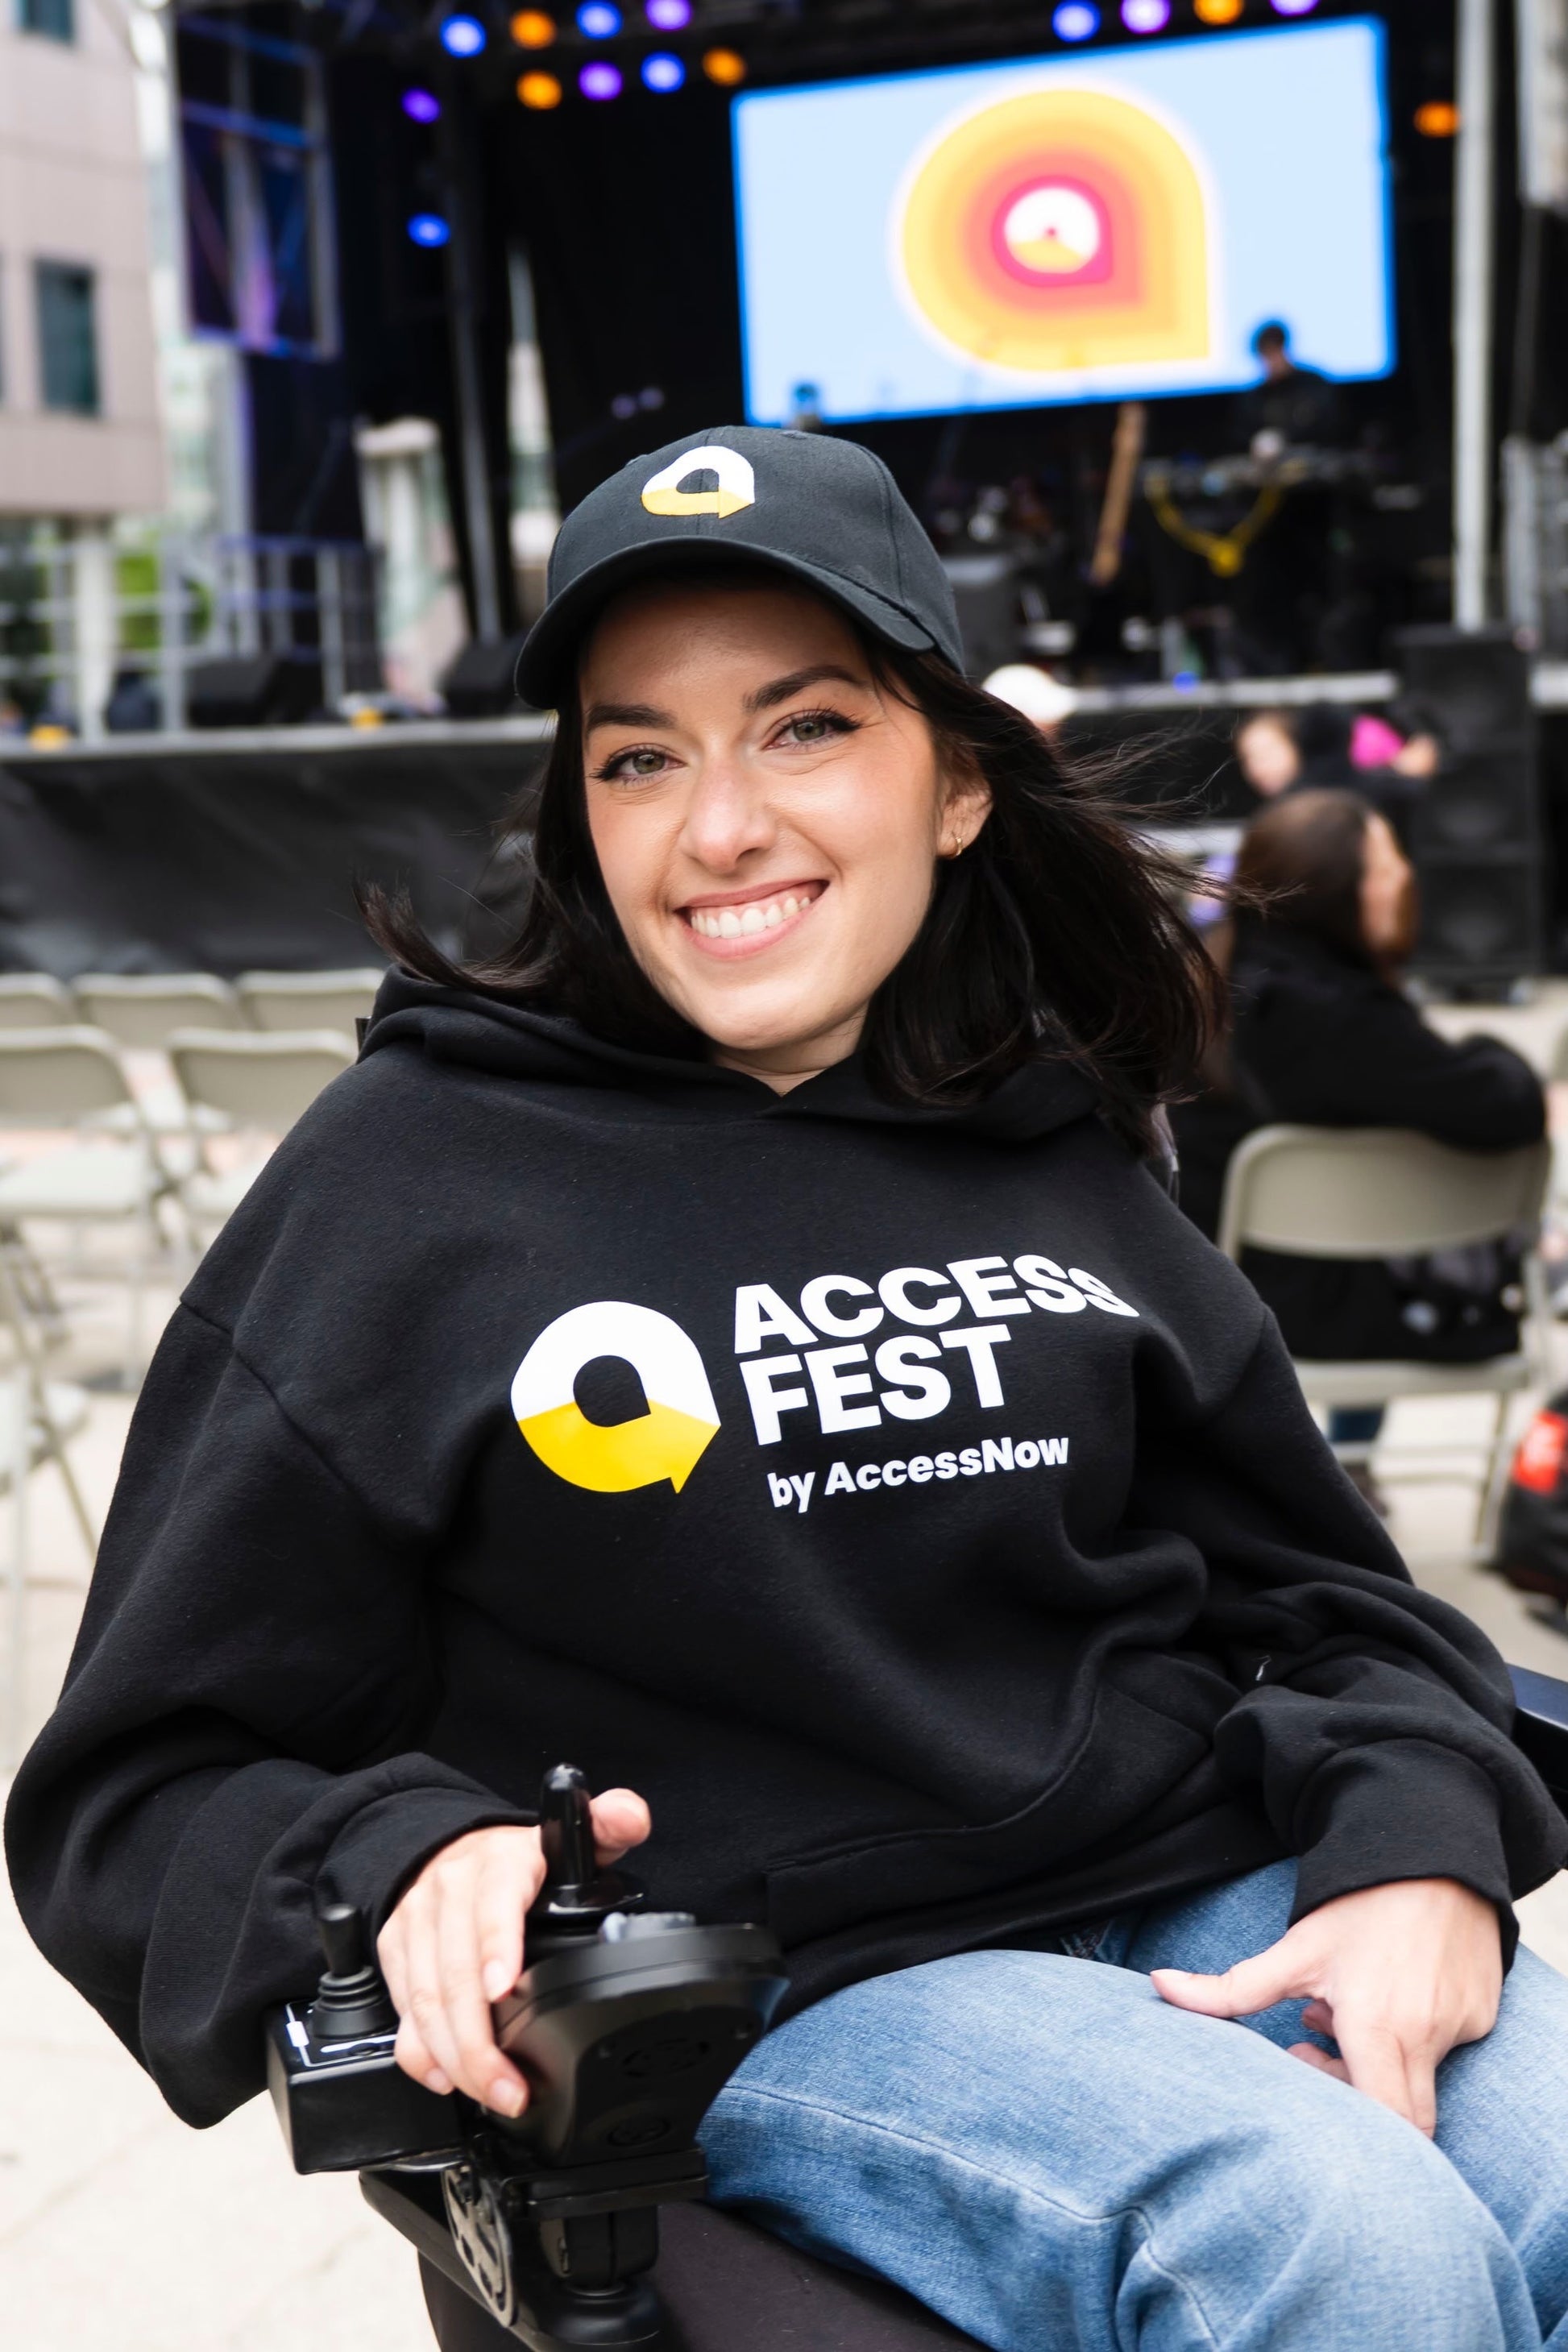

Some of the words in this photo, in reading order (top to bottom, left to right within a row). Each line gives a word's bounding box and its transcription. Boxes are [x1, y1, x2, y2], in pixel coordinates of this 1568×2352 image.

[734, 1254, 1141, 1354] ACCESS
[739, 1323, 1012, 1446] FEST
[766, 1471, 816, 1514] by
[823, 1437, 1069, 1495] AccessNow
